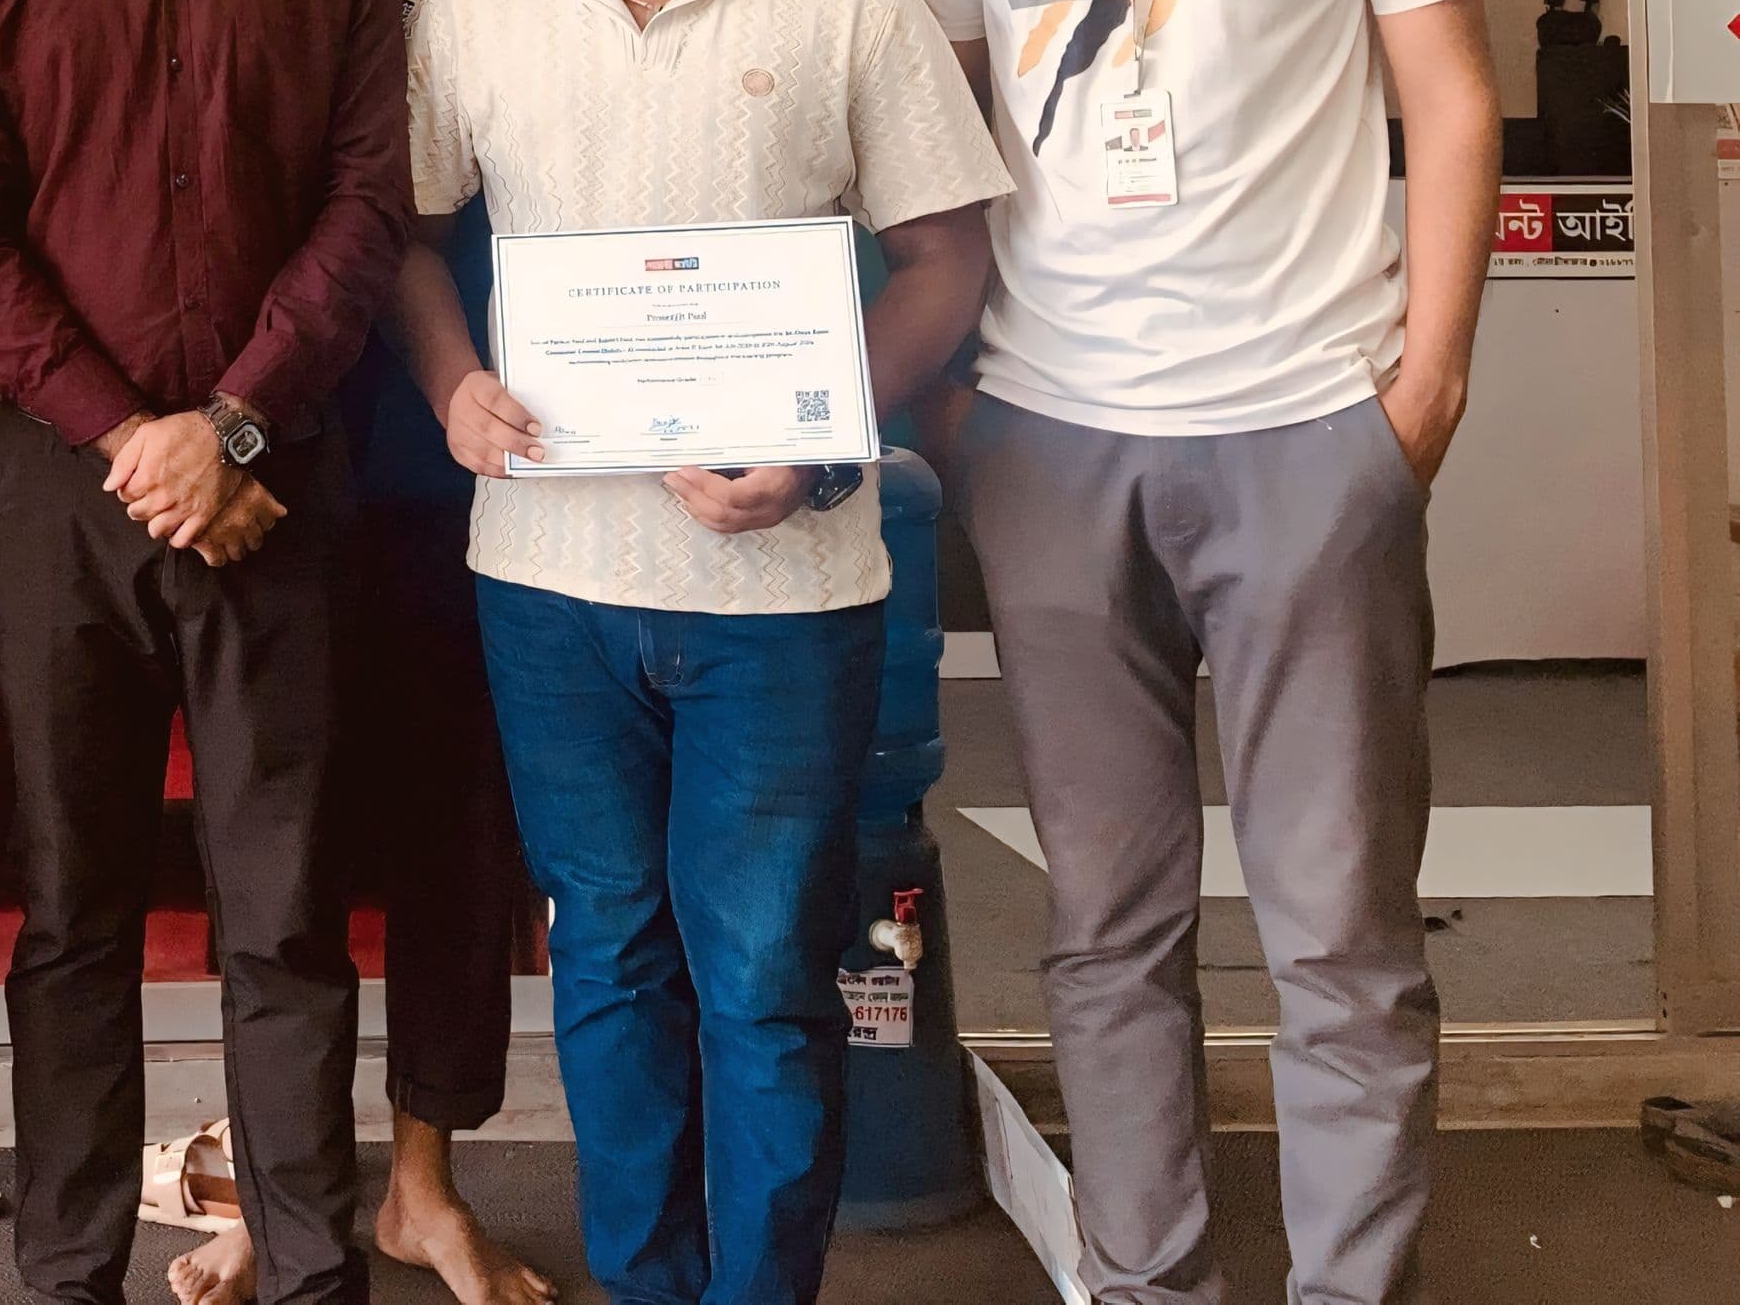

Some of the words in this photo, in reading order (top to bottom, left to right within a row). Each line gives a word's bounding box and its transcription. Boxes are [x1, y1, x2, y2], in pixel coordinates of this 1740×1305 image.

[568, 286, 652, 298] CERTIFICATE
[658, 285, 674, 295] OF
[679, 280, 781, 293] PARTICIPATION
[854, 1006, 908, 1022] 617176
